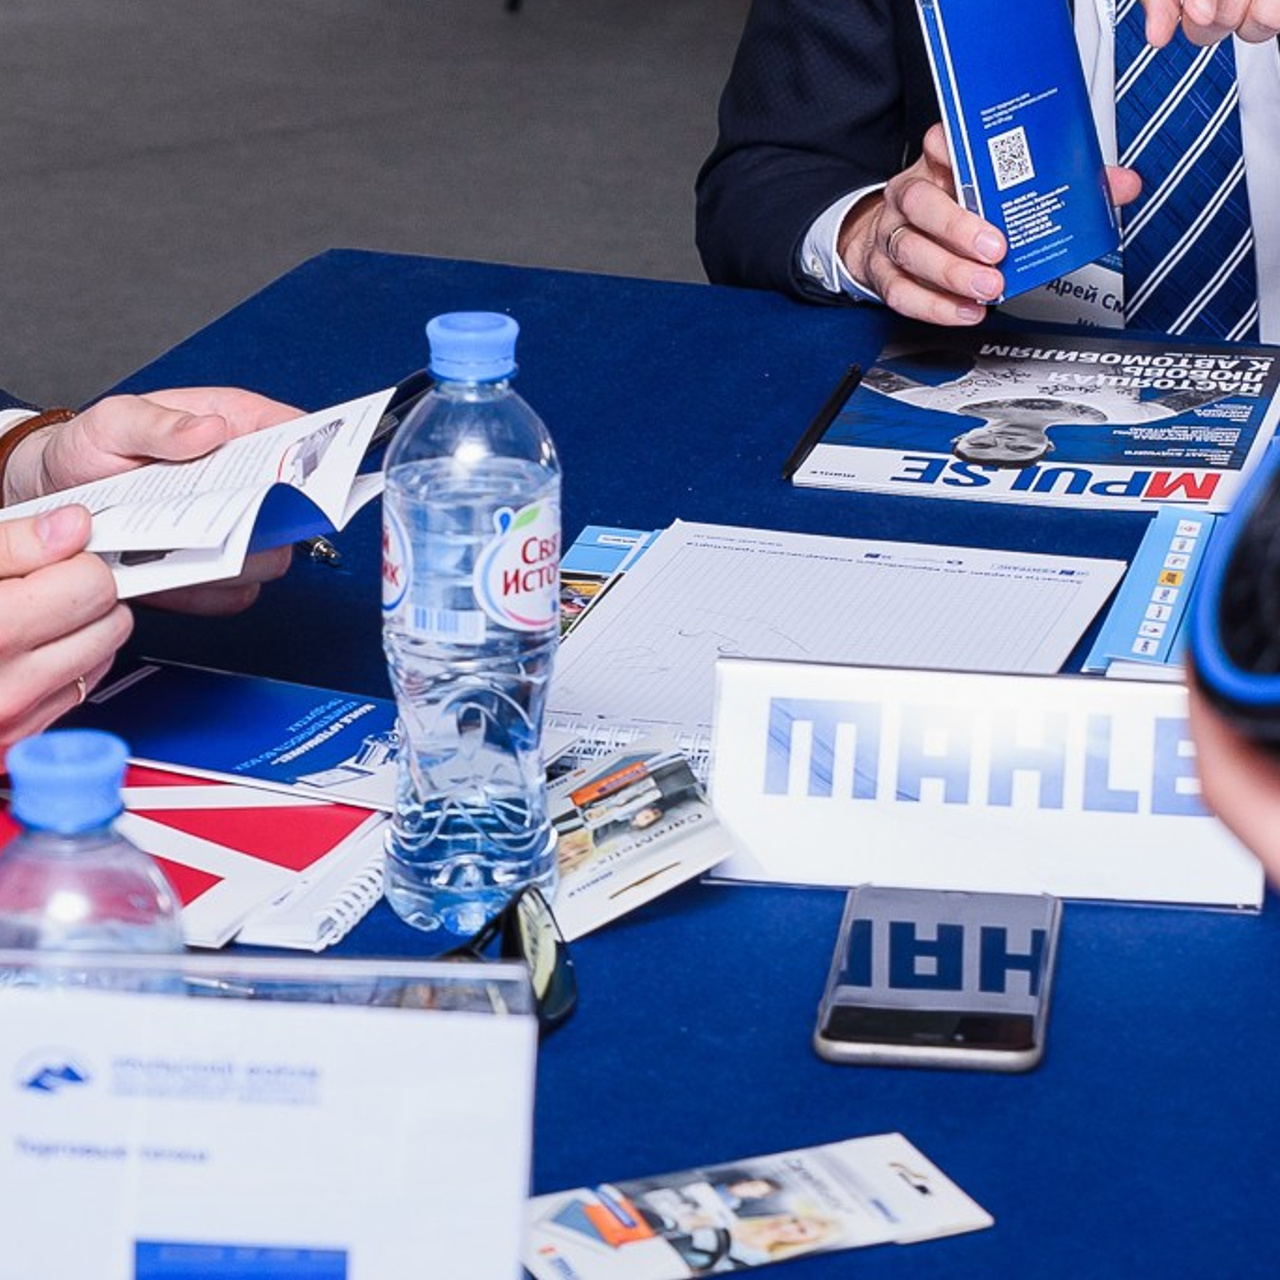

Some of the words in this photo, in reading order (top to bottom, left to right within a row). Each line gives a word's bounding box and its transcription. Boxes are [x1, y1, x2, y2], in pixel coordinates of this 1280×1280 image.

[980, 344, 1241, 371] АВТОМОБИЛЯМ
[1050, 372, 1263, 394] НАСТОЯЩАЯ
[1123, 365, 1270, 382] ЛЮБОВЬ
[762, 696, 1214, 818] MAHLE
